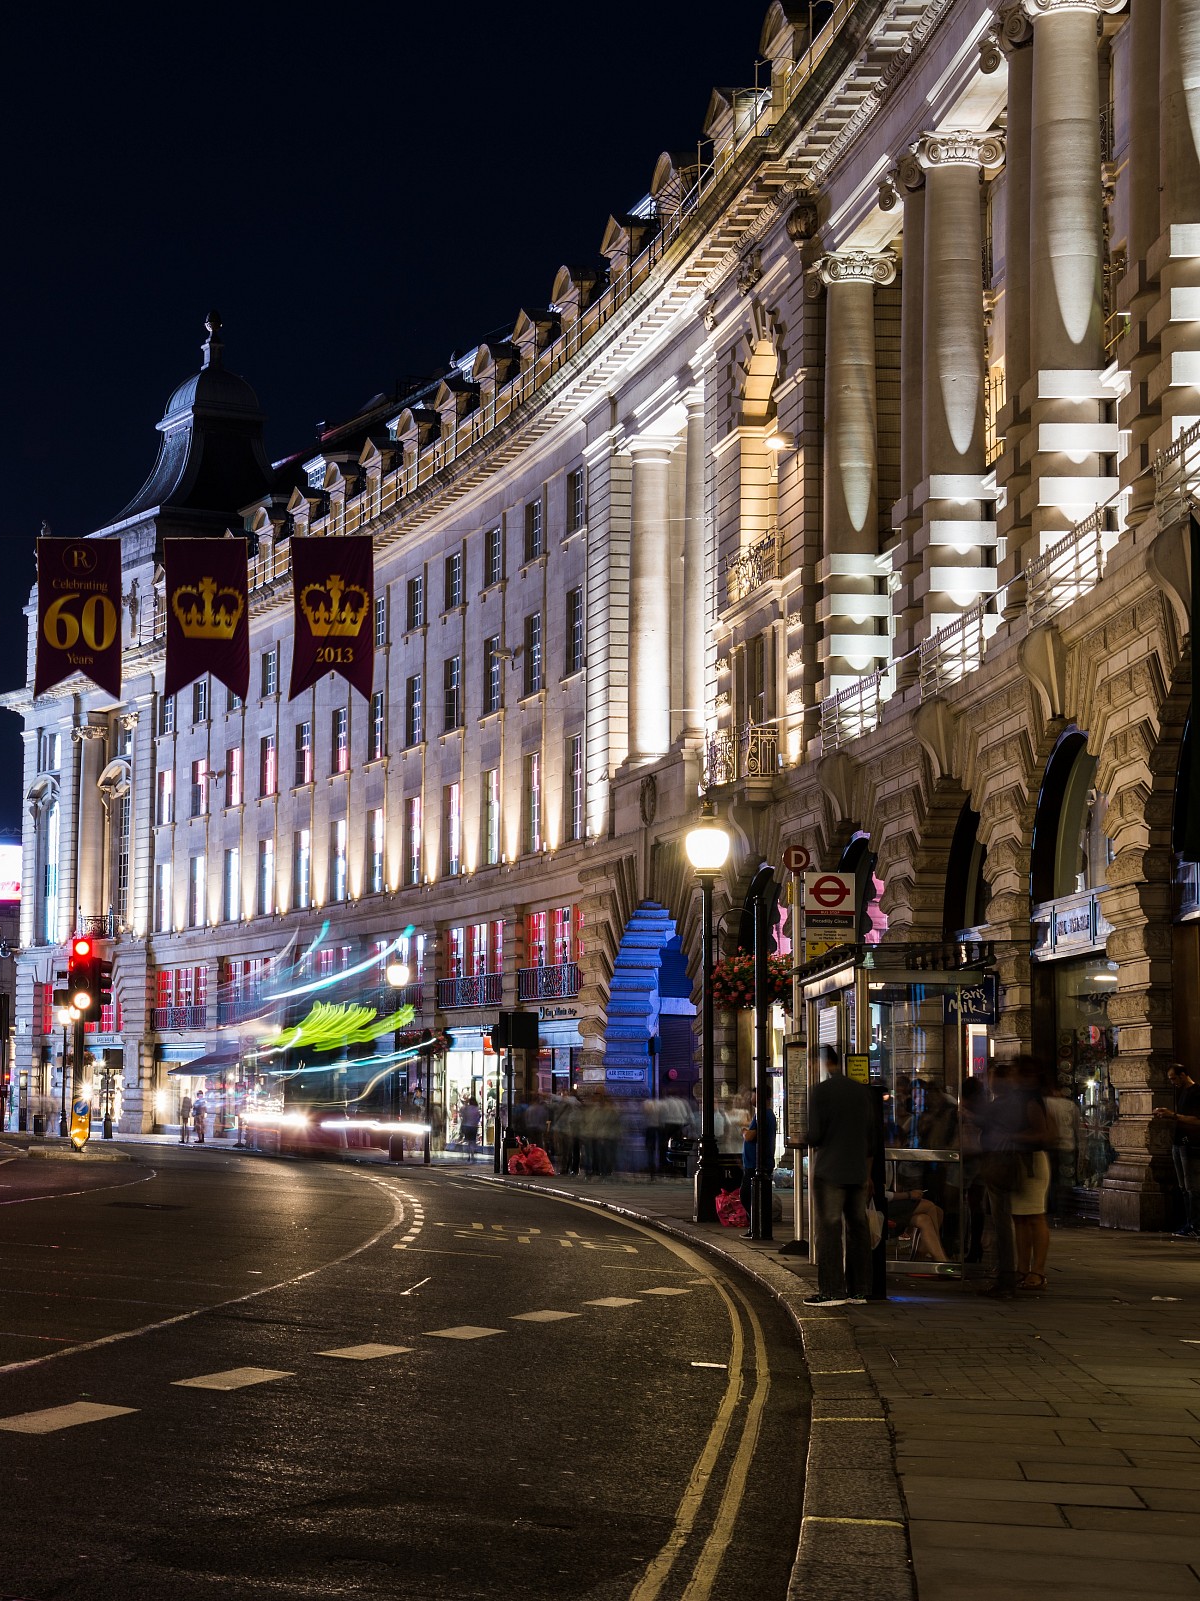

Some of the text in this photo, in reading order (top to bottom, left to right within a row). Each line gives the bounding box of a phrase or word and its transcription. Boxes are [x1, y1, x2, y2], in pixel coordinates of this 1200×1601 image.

[72, 550, 92, 568] R
[52, 578, 108, 593] Celebrating
[43, 593, 117, 651] 60
[67, 652, 94, 665] Years
[316, 647, 354, 663] 2013
[791, 850, 807, 868] D
[948, 999, 990, 1016] Miki
